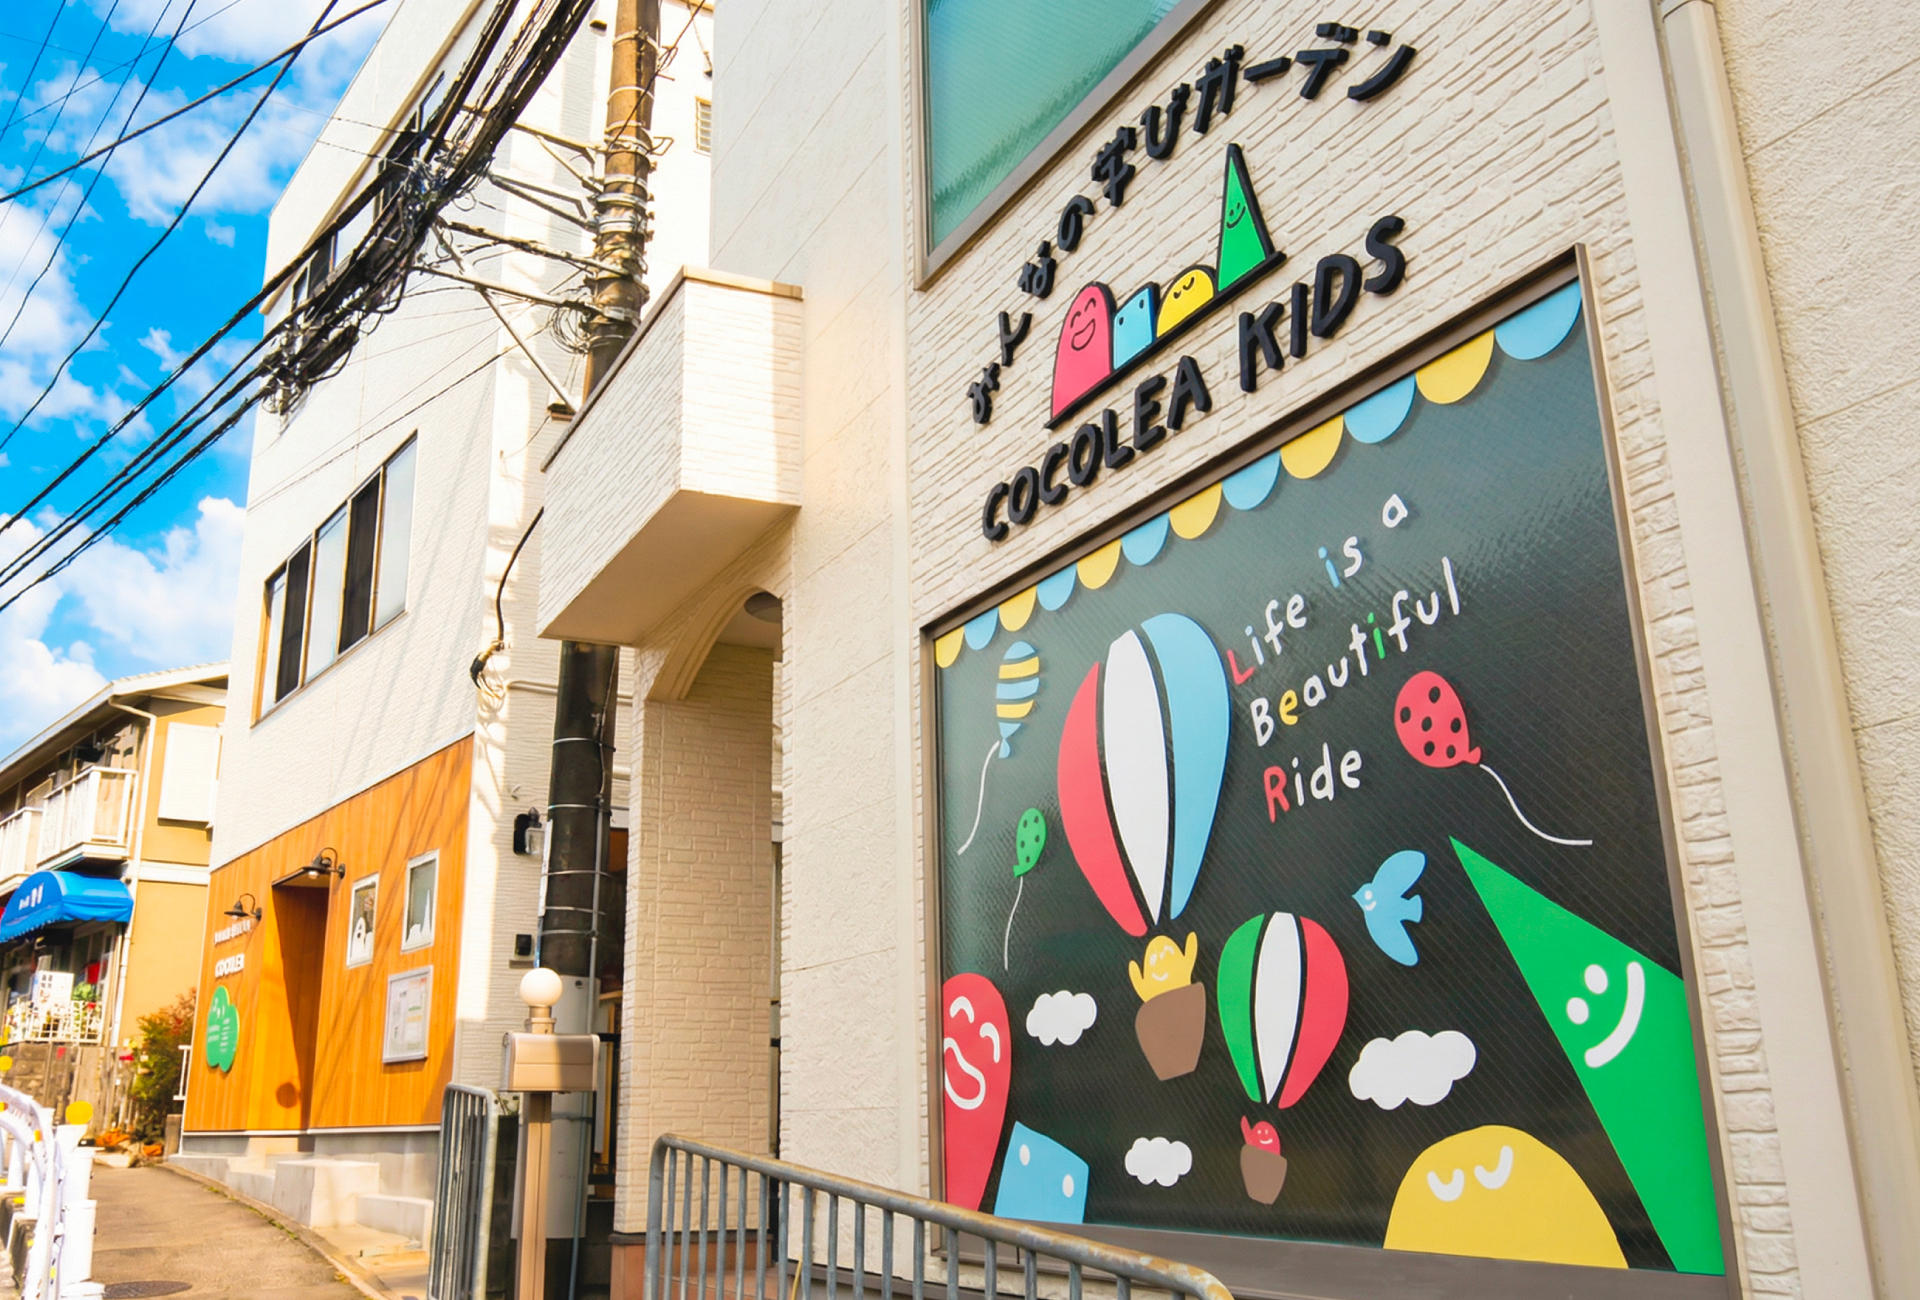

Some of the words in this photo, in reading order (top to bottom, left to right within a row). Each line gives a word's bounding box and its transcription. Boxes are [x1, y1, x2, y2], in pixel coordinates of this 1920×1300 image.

[966, 22, 1417, 424] みんなの学びガーデン
[982, 355, 1213, 541] COCOLEA
[1238, 215, 1406, 392] KIDS
[1226, 594, 1307, 686] Life
[1318, 536, 1364, 588] is
[1382, 493, 1409, 528] a
[1250, 556, 1461, 747] Beautiful
[1264, 742, 1363, 823] Ride
